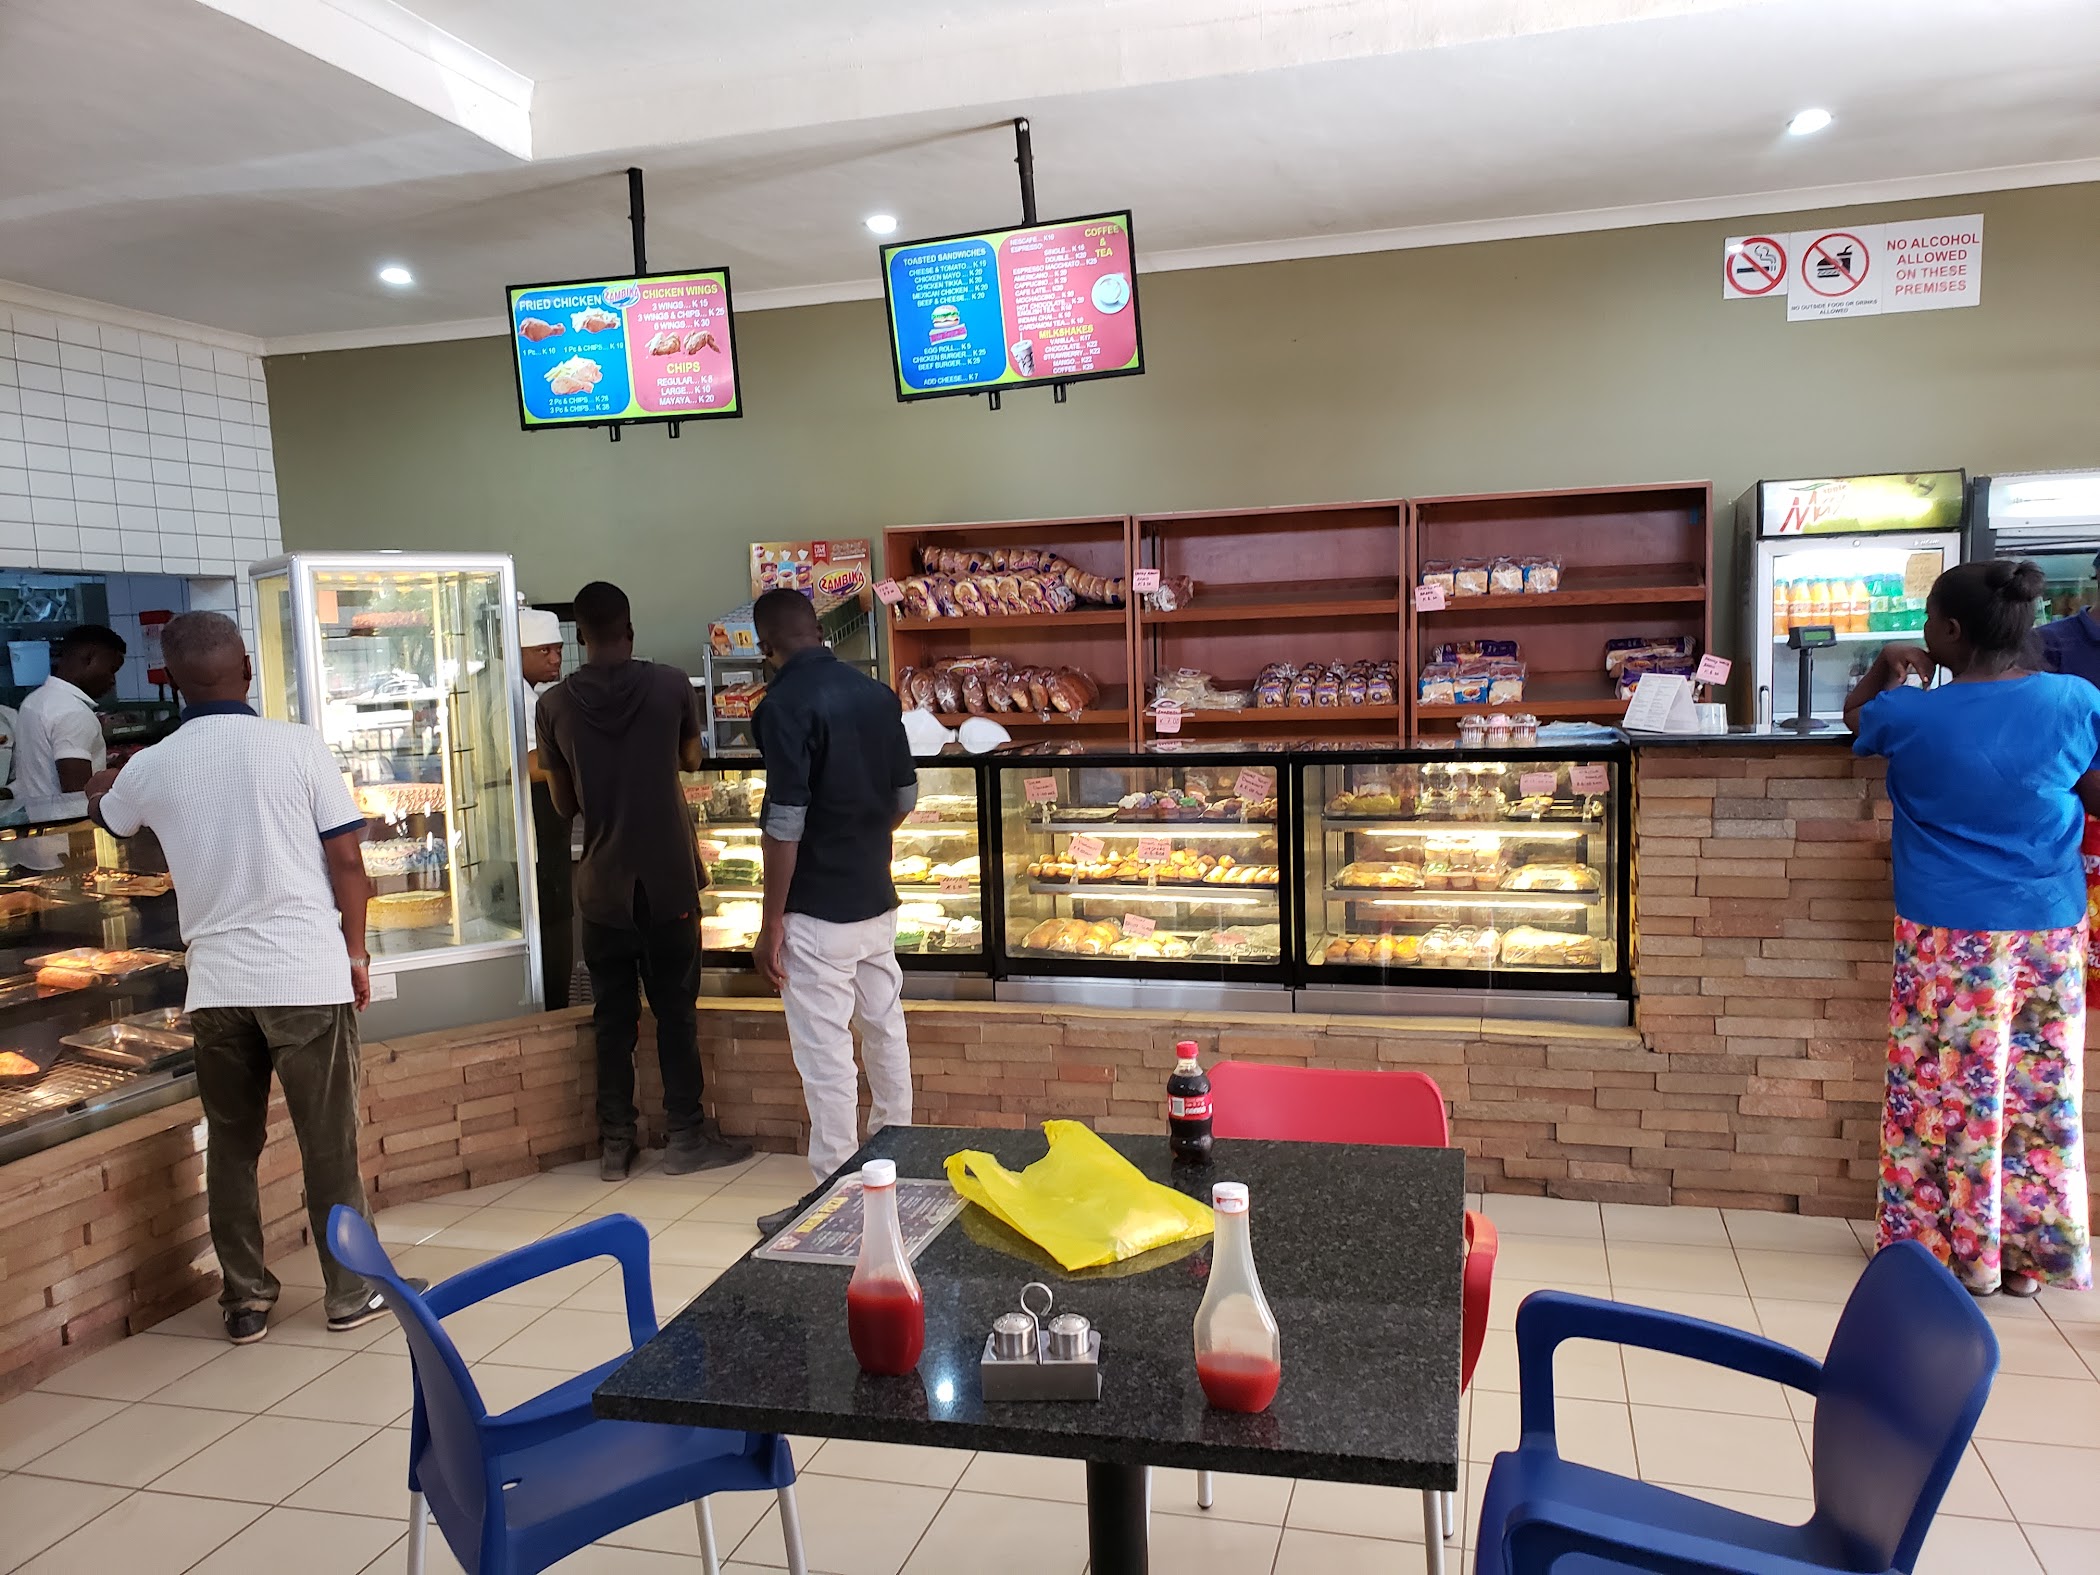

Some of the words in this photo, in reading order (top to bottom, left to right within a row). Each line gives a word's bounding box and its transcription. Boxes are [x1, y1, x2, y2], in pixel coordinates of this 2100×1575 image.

[1085, 225, 1119, 237] COFFEE
[1099, 237, 1106, 246] &
[1887, 239, 1906, 251] NO
[1911, 233, 1980, 248] ALCOHOL
[903, 255, 936, 266] TOASTED
[938, 248, 986, 261] SANDWICHES
[1095, 247, 1113, 258] TEA
[1896, 250, 1967, 265] ALLOWED
[909, 267, 934, 276] CHEESE
[1896, 268, 1916, 281] ON
[1921, 265, 1967, 278] THESE
[914, 274, 942, 284] CHICKEN
[943, 272, 960, 280] MAYO
[642, 286, 684, 299] CHICKEN
[686, 284, 718, 296] WINGS
[916, 282, 943, 291] CHICKEN
[1895, 280, 1966, 296] PREMISES
[912, 290, 940, 300] MEXICAN
[520, 299, 551, 311] FRIED
[553, 295, 602, 308] CHICKEN
[652, 303, 657, 311] 3
[700, 299, 708, 307] 15
[917, 299, 932, 307] BEEF
[1801, 303, 1826, 311] OUTSIDE
[1827, 301, 1844, 309] FOOD
[643, 312, 669, 321] WINGS
[1039, 325, 1094, 339] MILKSHAKES
[667, 362, 700, 374] CHIPS
[918, 363, 934, 371] BEEF
[694, 386, 700, 394] K
[702, 385, 710, 393] 10
[698, 395, 705, 403] K
[822, 570, 864, 591] ZAMBIKA
